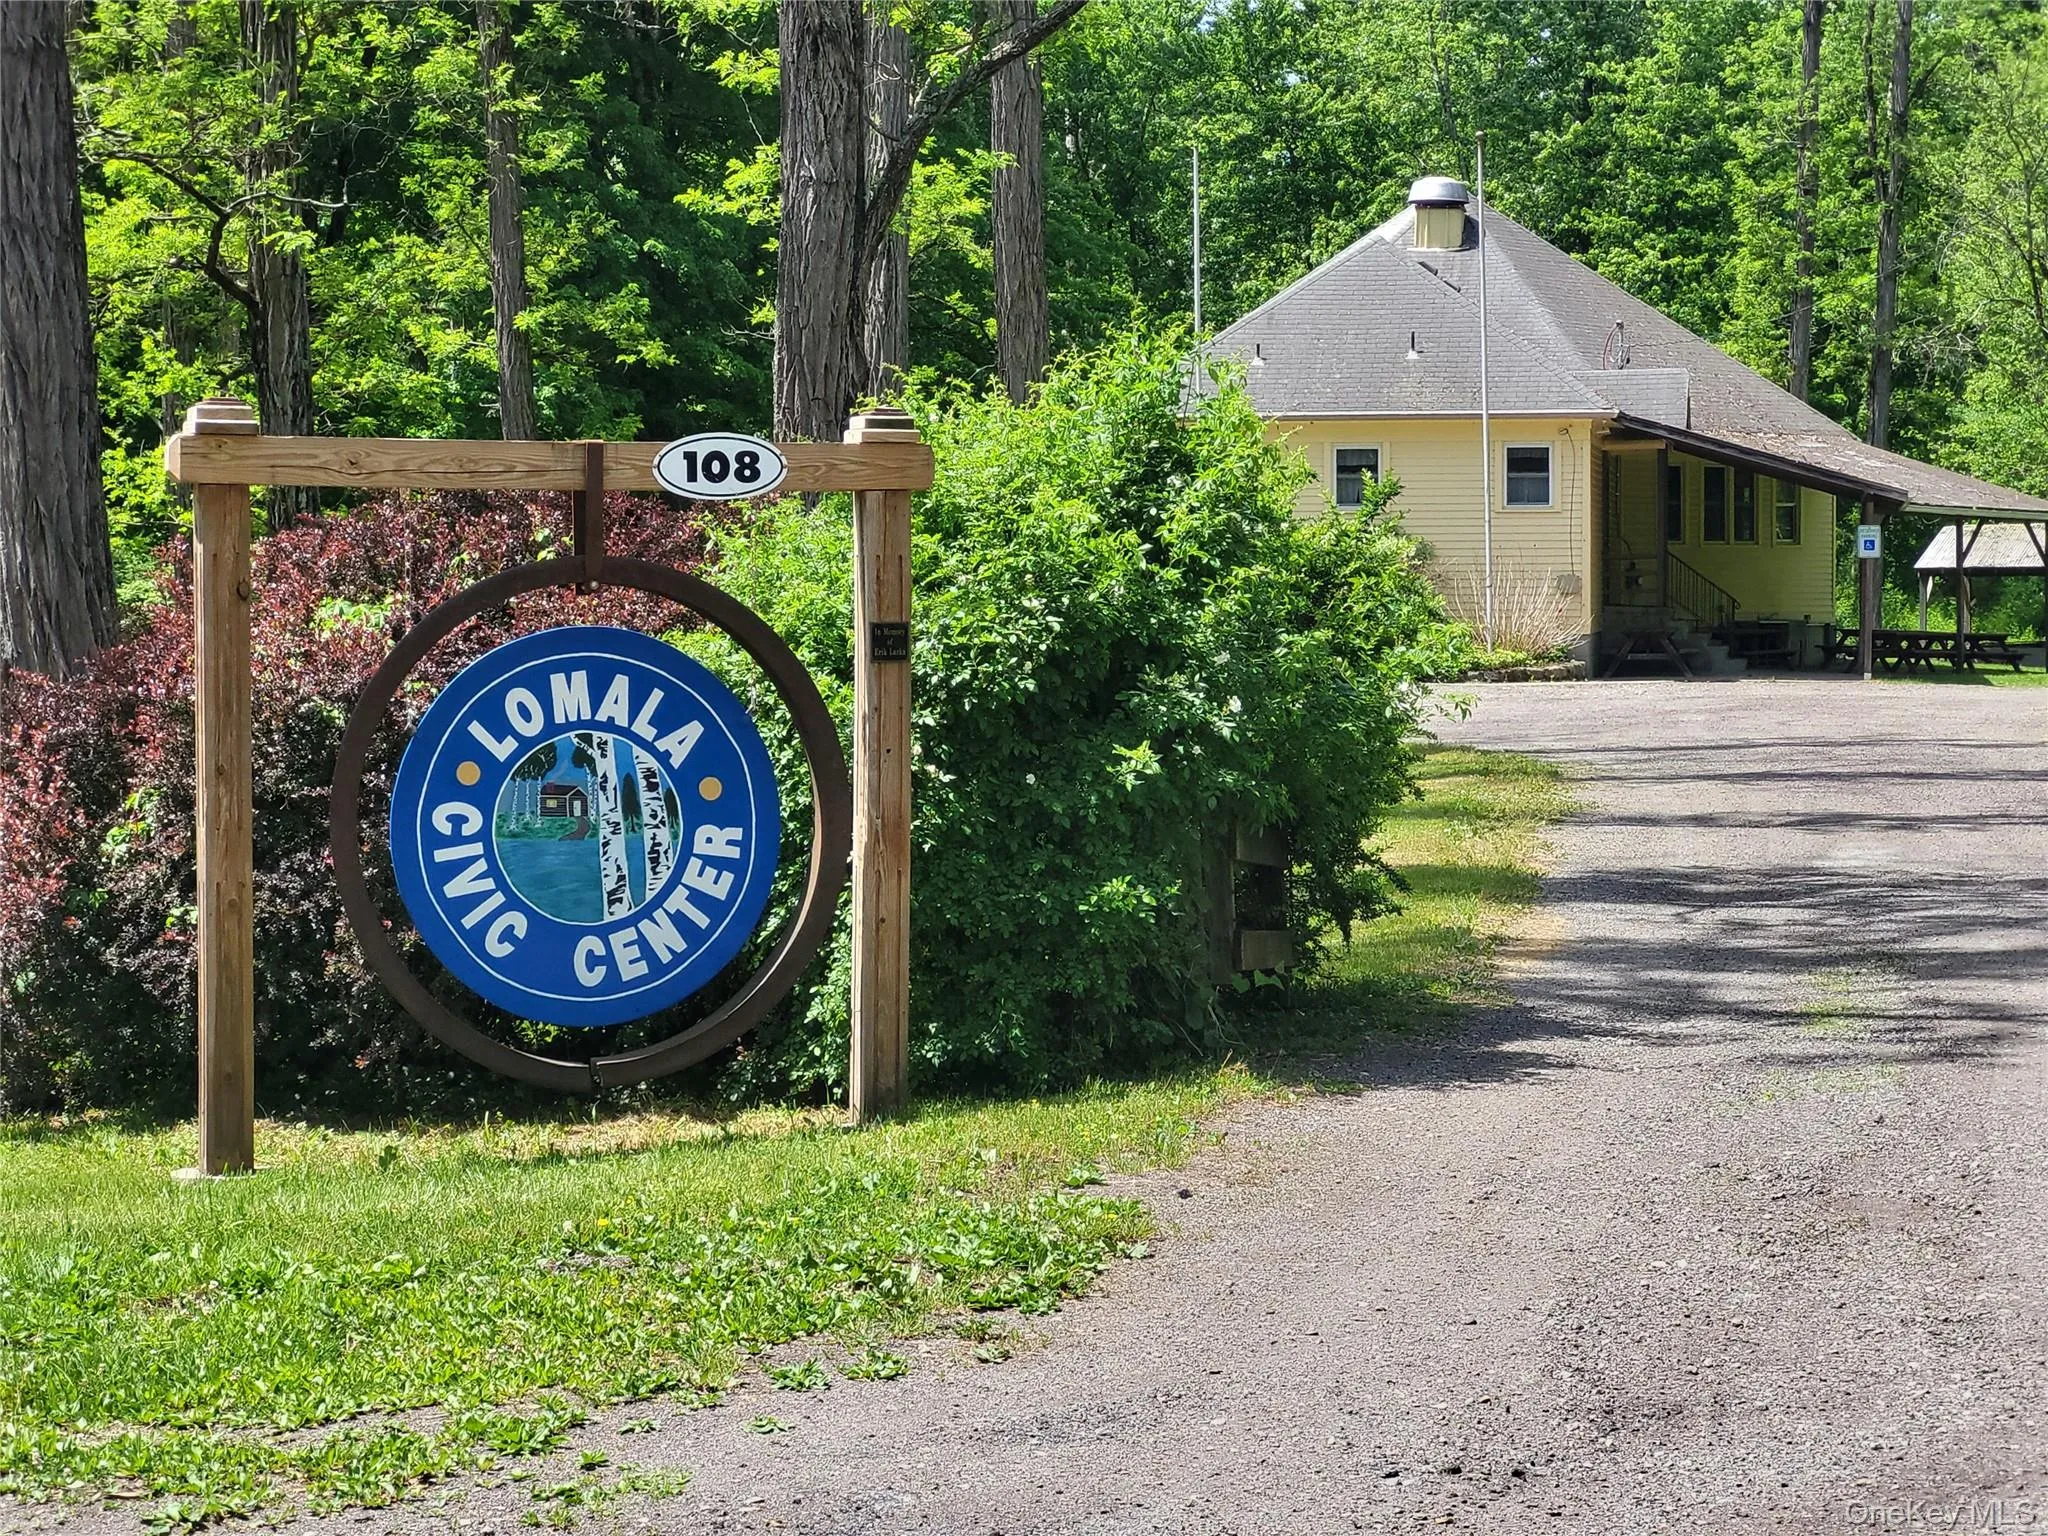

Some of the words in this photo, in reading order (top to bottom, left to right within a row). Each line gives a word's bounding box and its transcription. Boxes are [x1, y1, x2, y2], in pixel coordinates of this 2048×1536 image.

[683, 450, 761, 484] 108
[467, 670, 705, 770] LOMALA
[432, 801, 528, 959] CIVIC
[573, 824, 744, 988] CENTER
